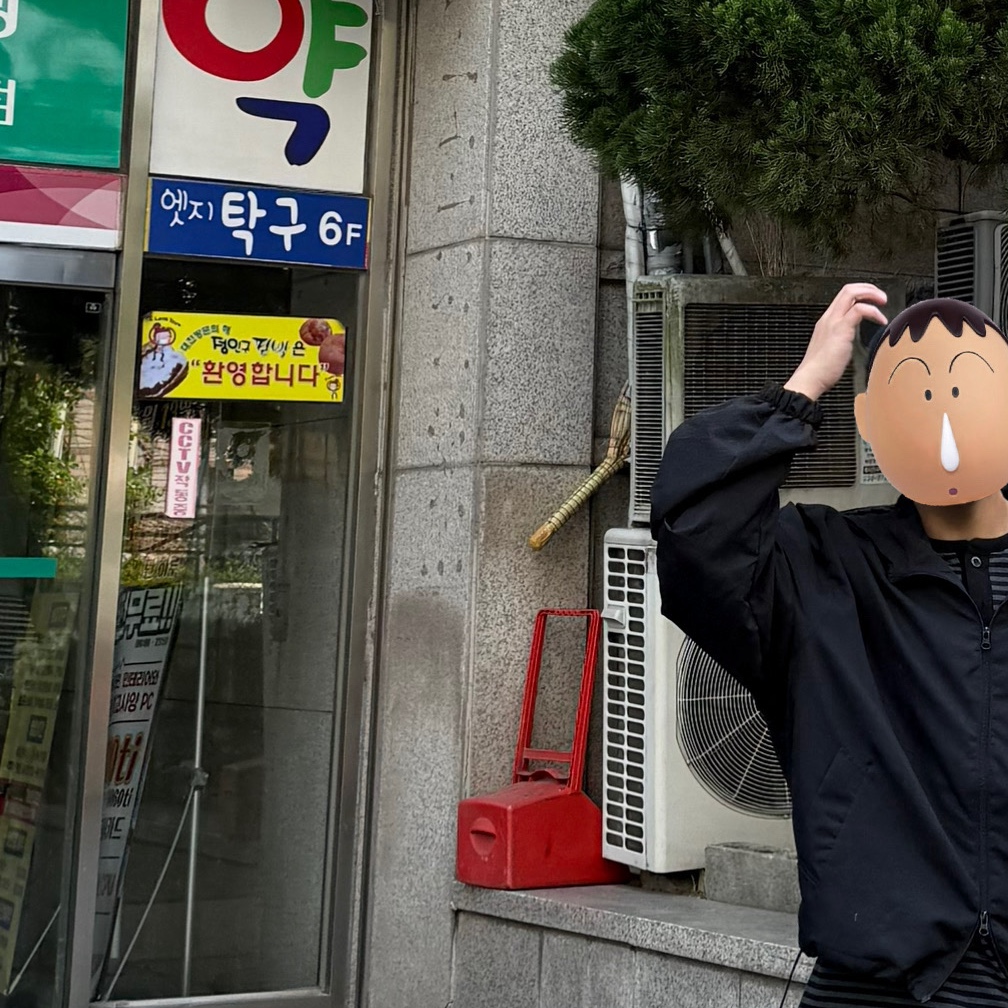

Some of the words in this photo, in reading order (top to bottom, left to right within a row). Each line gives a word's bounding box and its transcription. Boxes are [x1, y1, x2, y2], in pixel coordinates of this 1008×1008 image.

[161, 0, 369, 166] 약
[221, 190, 307, 256] 탁구
[318, 210, 363, 247] 6F
